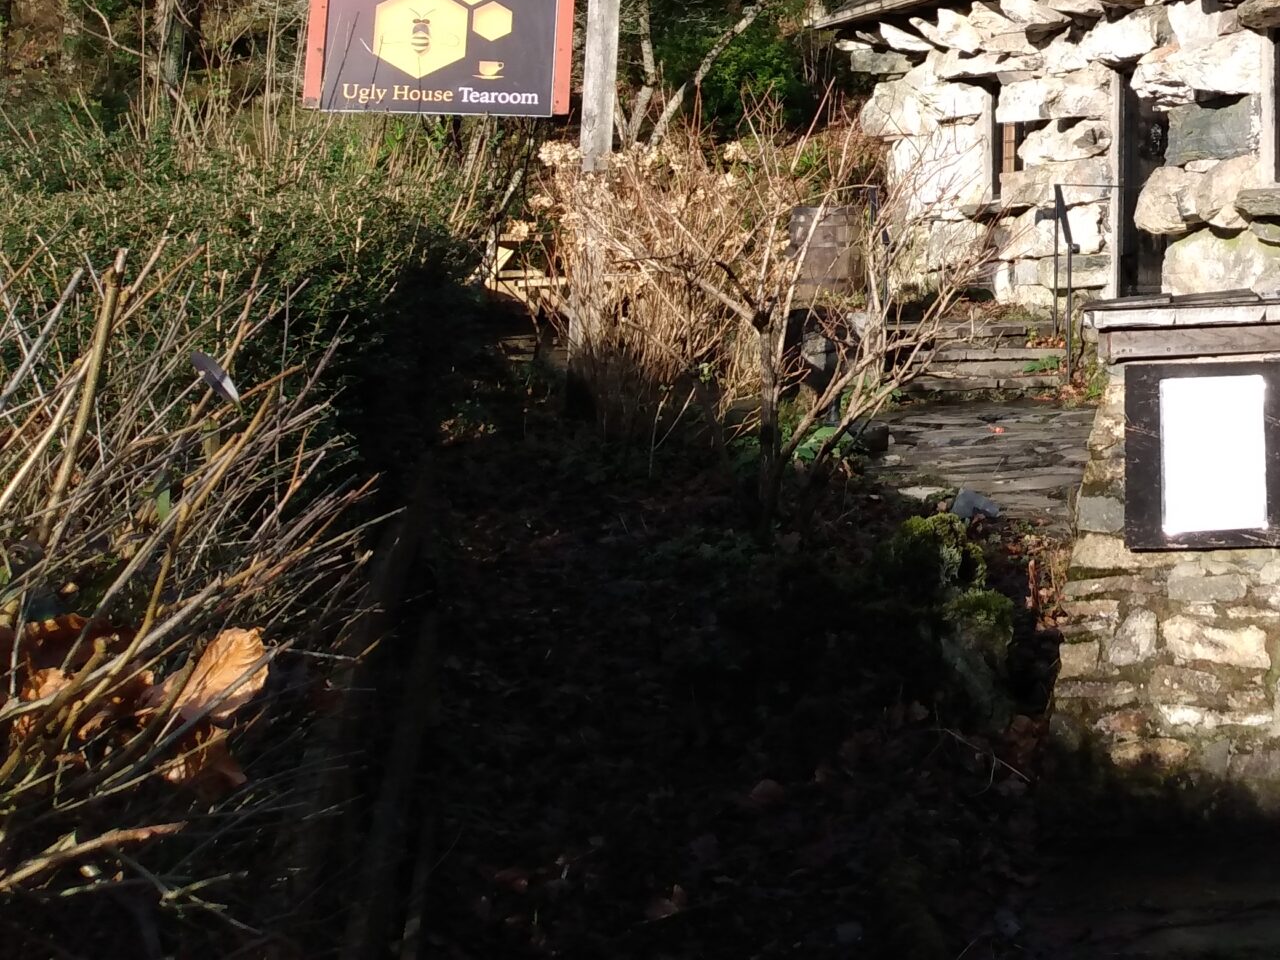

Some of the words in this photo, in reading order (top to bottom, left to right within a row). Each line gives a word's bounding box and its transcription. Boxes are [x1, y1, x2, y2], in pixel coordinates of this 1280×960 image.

[342, 83, 387, 104] Ugly
[392, 84, 453, 103] House
[458, 87, 539, 105] Tearoom
